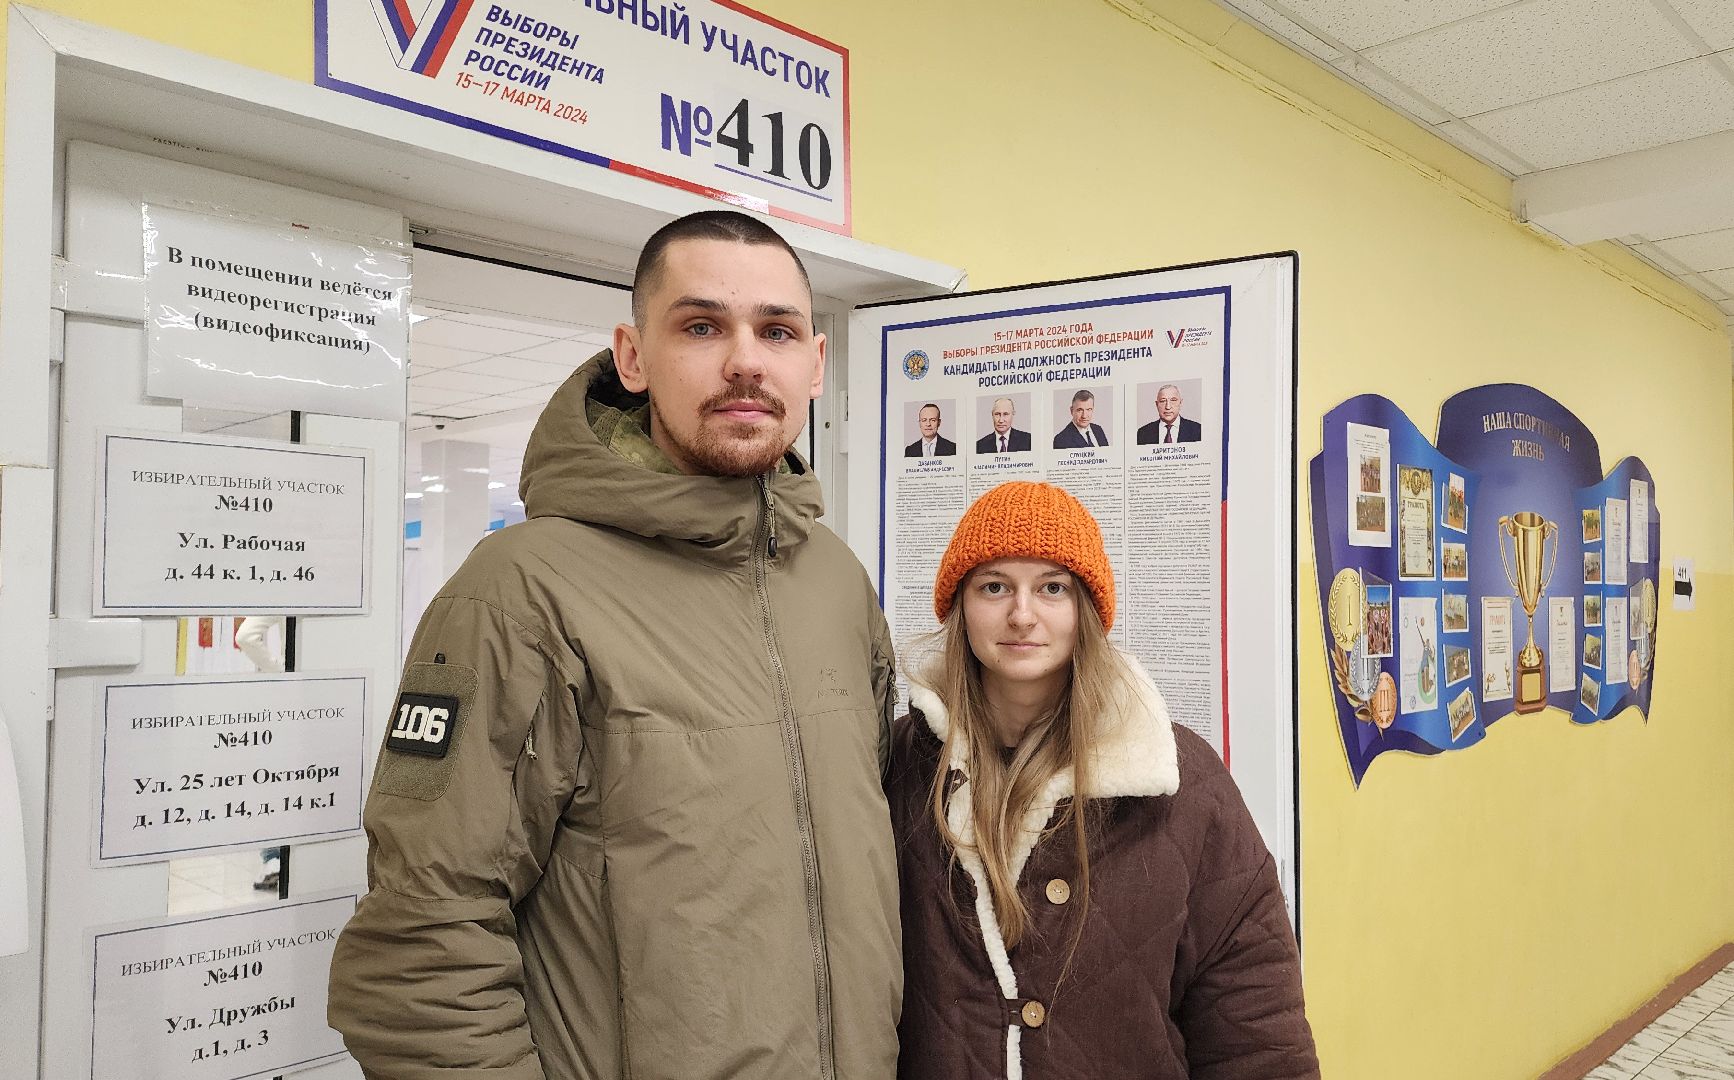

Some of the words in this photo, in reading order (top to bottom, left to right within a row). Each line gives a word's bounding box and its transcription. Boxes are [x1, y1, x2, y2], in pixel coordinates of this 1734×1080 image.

[485, 4, 580, 50] ВЫБОРЫ
[463, 49, 552, 91] РОССИИ
[474, 26, 606, 84] ПРЕЗИДЕНТА
[700, 20, 831, 98] УЧАСТОК
[500, 86, 551, 115] МАРТА
[553, 103, 589, 126] 2024
[660, 92, 832, 191] №410
[167, 246, 183, 264] В
[190, 254, 314, 289] помещении
[319, 279, 394, 302] ведётся
[186, 283, 377, 327] видеорегистрация
[194, 311, 371, 355] (видеофиксация)
[943, 346, 978, 360] ВЫБОРЫ
[1034, 334, 1094, 350] РОССИЙСКОЙ
[1096, 329, 1154, 345] ФЕДЕРАЦИИ
[1015, 327, 1044, 340] МАРТА
[1046, 325, 1067, 336] 2024
[1069, 322, 1094, 334] ГОДА
[943, 361, 1001, 376] КАНДИДАТЫ
[1003, 358, 1016, 371] НА
[1017, 352, 1081, 371] ДОЛЖНОСТЬ
[1084, 346, 1153, 363] ПРЕЗИДЕНТА
[978, 369, 1043, 388] РОССИЙСКОЙ
[1045, 366, 1112, 382] ФЕДЕРАЦИИ
[1482, 411, 1512, 433] НАША
[1511, 439, 1545, 461] ЖИЗНЬ
[131, 470, 272, 491] ИЗБИРАТЕЛЬНЫЙ
[276, 479, 346, 495] УЧАСТОК
[214, 494, 273, 513] №410
[176, 531, 215, 550] Ул.
[221, 533, 306, 553] Рабочая
[164, 567, 184, 581] д.
[191, 563, 215, 580] 44
[222, 569, 241, 581] к.
[248, 566, 265, 583] 1,
[269, 570, 287, 582] д.
[293, 566, 316, 582] 46
[131, 709, 272, 730] ИЗБИРАТЕЛЬНЫЙ
[276, 707, 346, 723] УЧАСТОК
[392, 703, 450, 743] 106
[213, 729, 274, 749] №410
[133, 777, 173, 796] Ул.
[179, 773, 204, 792] 25
[209, 774, 247, 789] лет
[252, 764, 341, 786] Октября
[132, 813, 153, 829] д.
[162, 807, 192, 826] 12,
[198, 809, 216, 822] д.
[224, 802, 252, 818] 14,
[257, 801, 275, 815] д.
[283, 796, 304, 812] 14
[309, 791, 336, 809] к.1
[120, 939, 263, 978] ИЗБИРАТЕЛЬНЫЙ
[266, 928, 337, 952] УЧАСТОК
[203, 961, 264, 987] №410
[164, 1016, 203, 1035] Ул.
[208, 995, 297, 1028] Дружбы
[191, 1039, 229, 1063] д.1,
[233, 1041, 252, 1055] д.
[257, 1029, 270, 1046] 3
